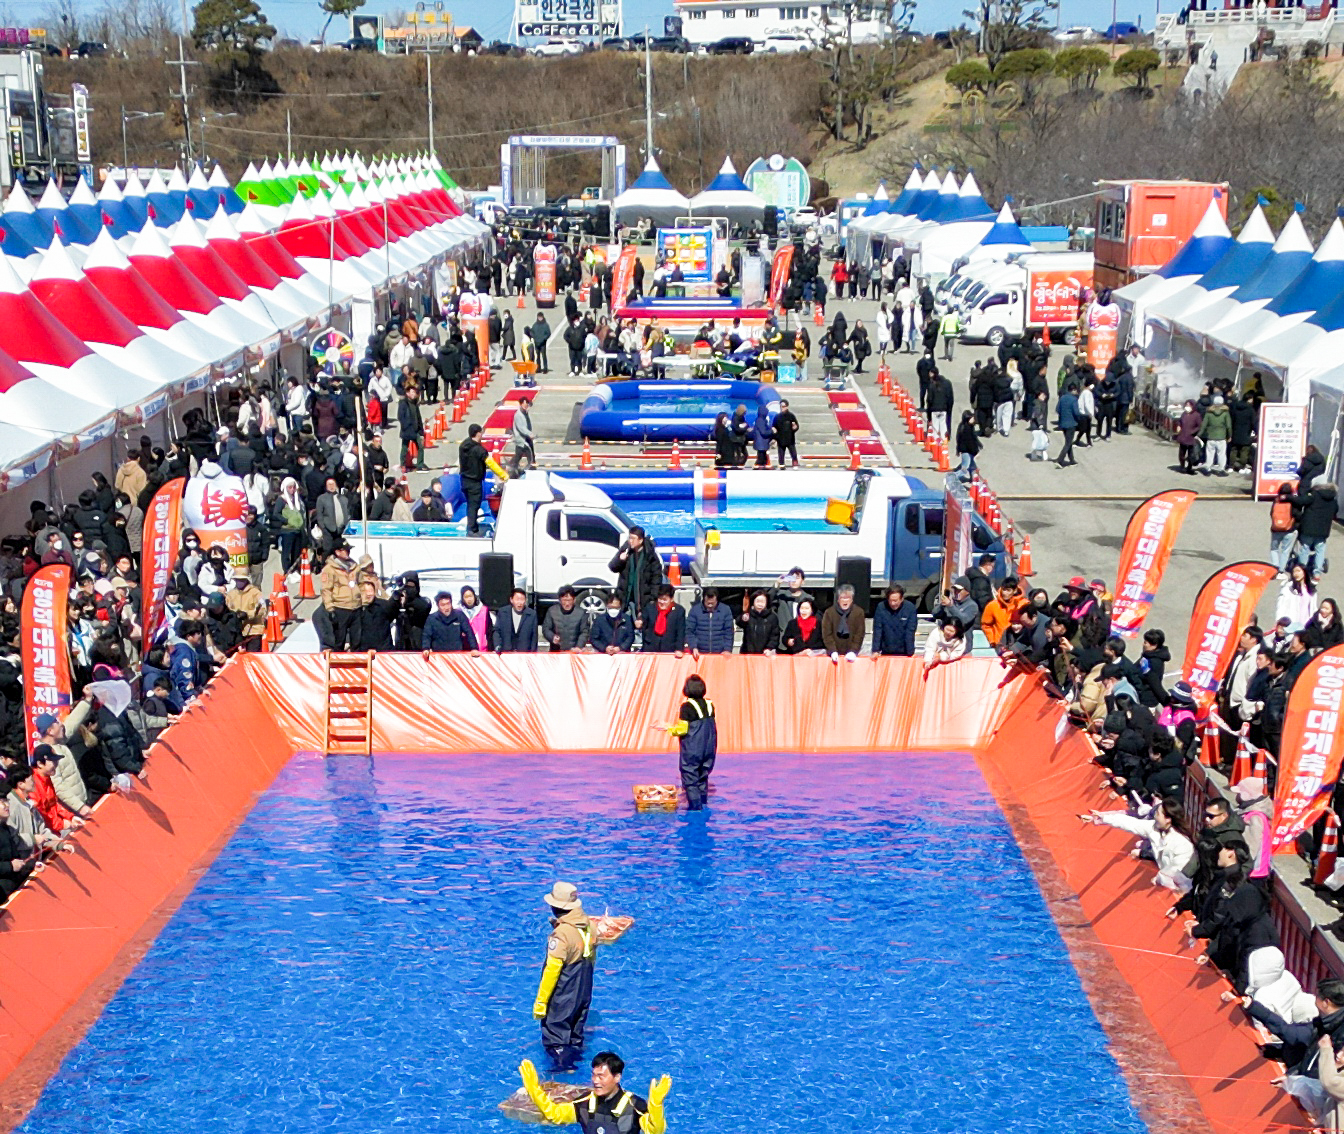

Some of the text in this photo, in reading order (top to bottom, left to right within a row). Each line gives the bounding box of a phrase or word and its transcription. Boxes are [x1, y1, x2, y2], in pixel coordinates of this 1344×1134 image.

[1120, 506, 1170, 601] 영덕대게축제
[32, 587, 59, 705] 영덕대게축제
[1188, 579, 1247, 687] 영덕대게축제
